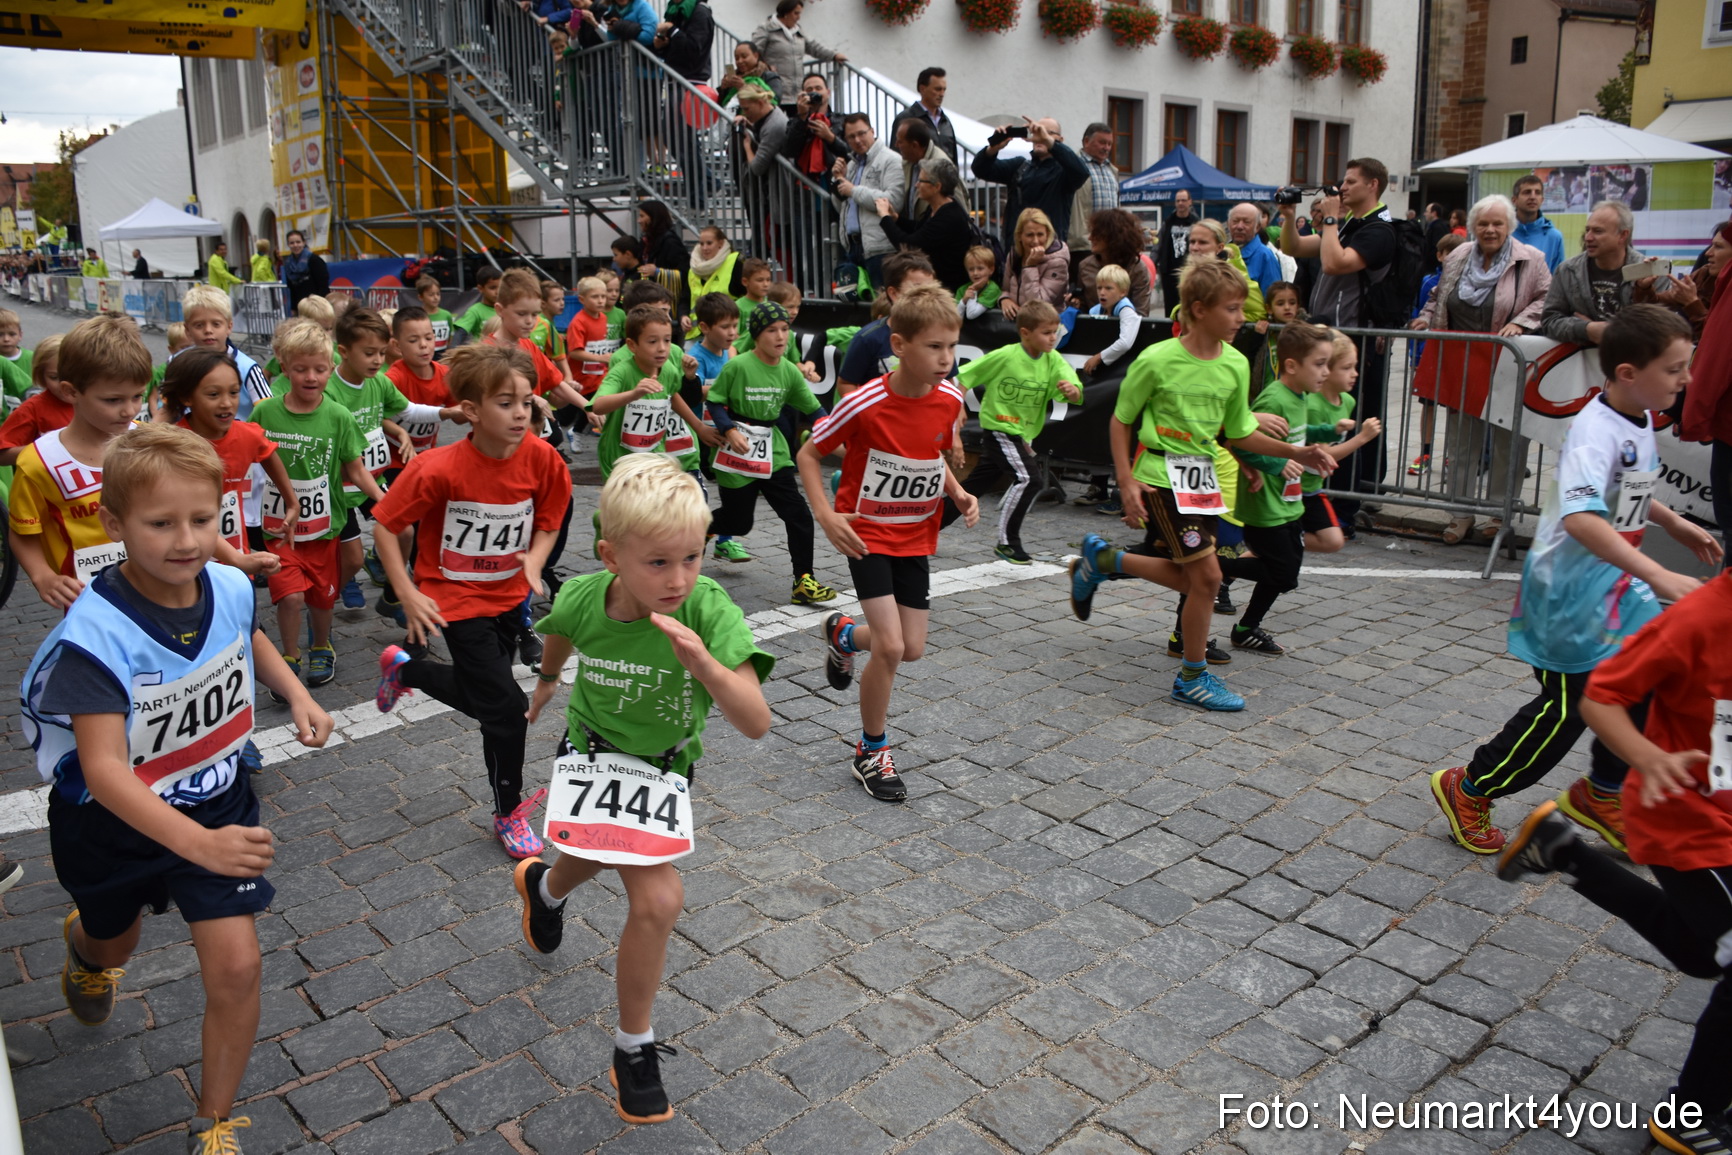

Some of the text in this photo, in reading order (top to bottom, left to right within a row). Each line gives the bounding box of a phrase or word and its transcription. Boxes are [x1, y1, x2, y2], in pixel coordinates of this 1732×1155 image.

[627, 403, 649, 411] PARTL
[265, 430, 313, 443] Neumarkter
[869, 456, 940, 473] PARTL Neumarkt
[873, 470, 942, 499] 7068
[269, 491, 325, 519] 786
[874, 504, 927, 516] Johannes
[448, 507, 524, 520] PARTL Neumarkt
[456, 518, 525, 552] 7141
[77, 553, 116, 568] PARTL
[473, 558, 500, 571] Max
[132, 692, 182, 715] PARTL
[184, 656, 235, 697] Neumarkt
[146, 669, 245, 754] 7402
[557, 763, 604, 775] PARTL
[568, 779, 679, 832] 7444
